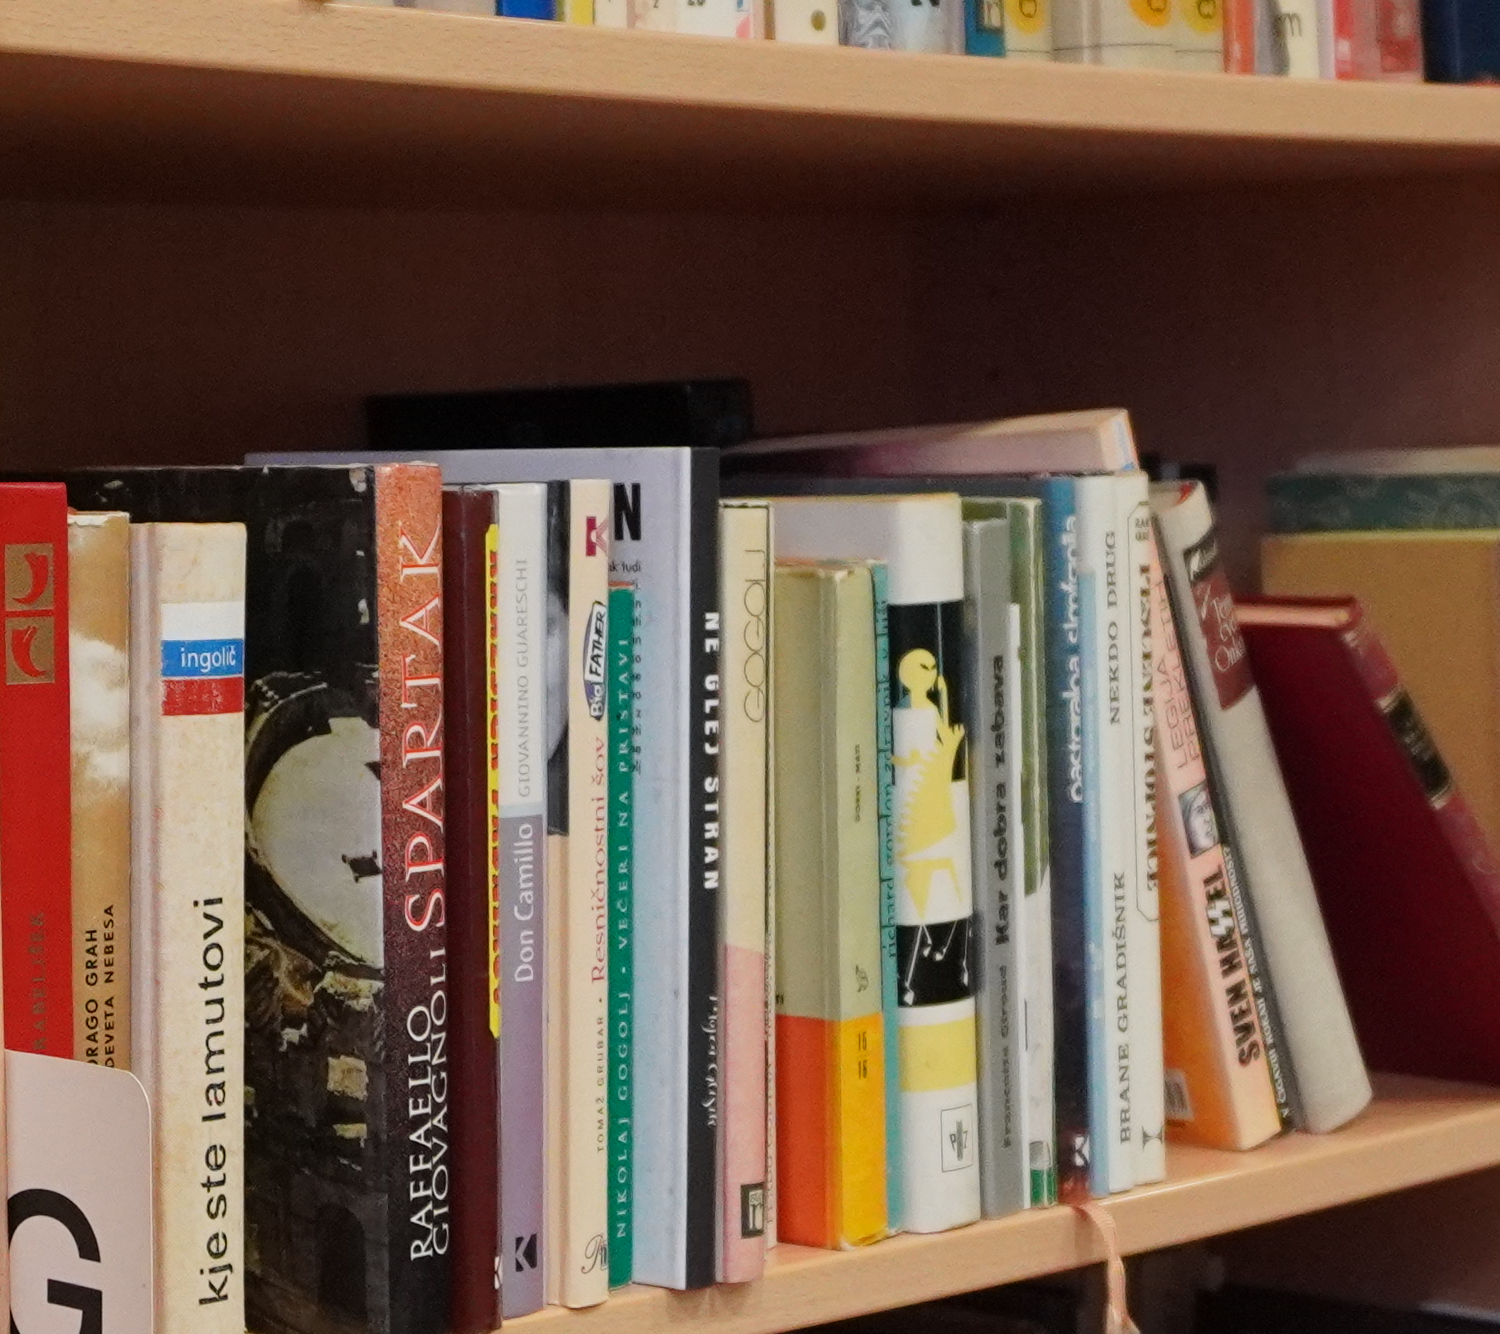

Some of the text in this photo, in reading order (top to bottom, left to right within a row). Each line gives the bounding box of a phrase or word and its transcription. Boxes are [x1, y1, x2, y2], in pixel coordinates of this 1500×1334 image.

[398, 515, 446, 934] SPARTAK
[512, 558, 532, 798] GIOVANNINO GUARESCHI
[740, 548, 770, 723] GOGOLJ
[1102, 531, 1122, 726] NEKDO DRUG
[508, 822, 538, 983] Don Camillo
[612, 638, 632, 1238] NIKOLAJ GOGOLJ VEČERI NA PRISTAVI
[1108, 872, 1133, 1144] BRANE GRADIŠNIK
[193, 894, 235, 1306] kje ste lamutovi
[405, 1003, 436, 1262] RAFFAELLO
